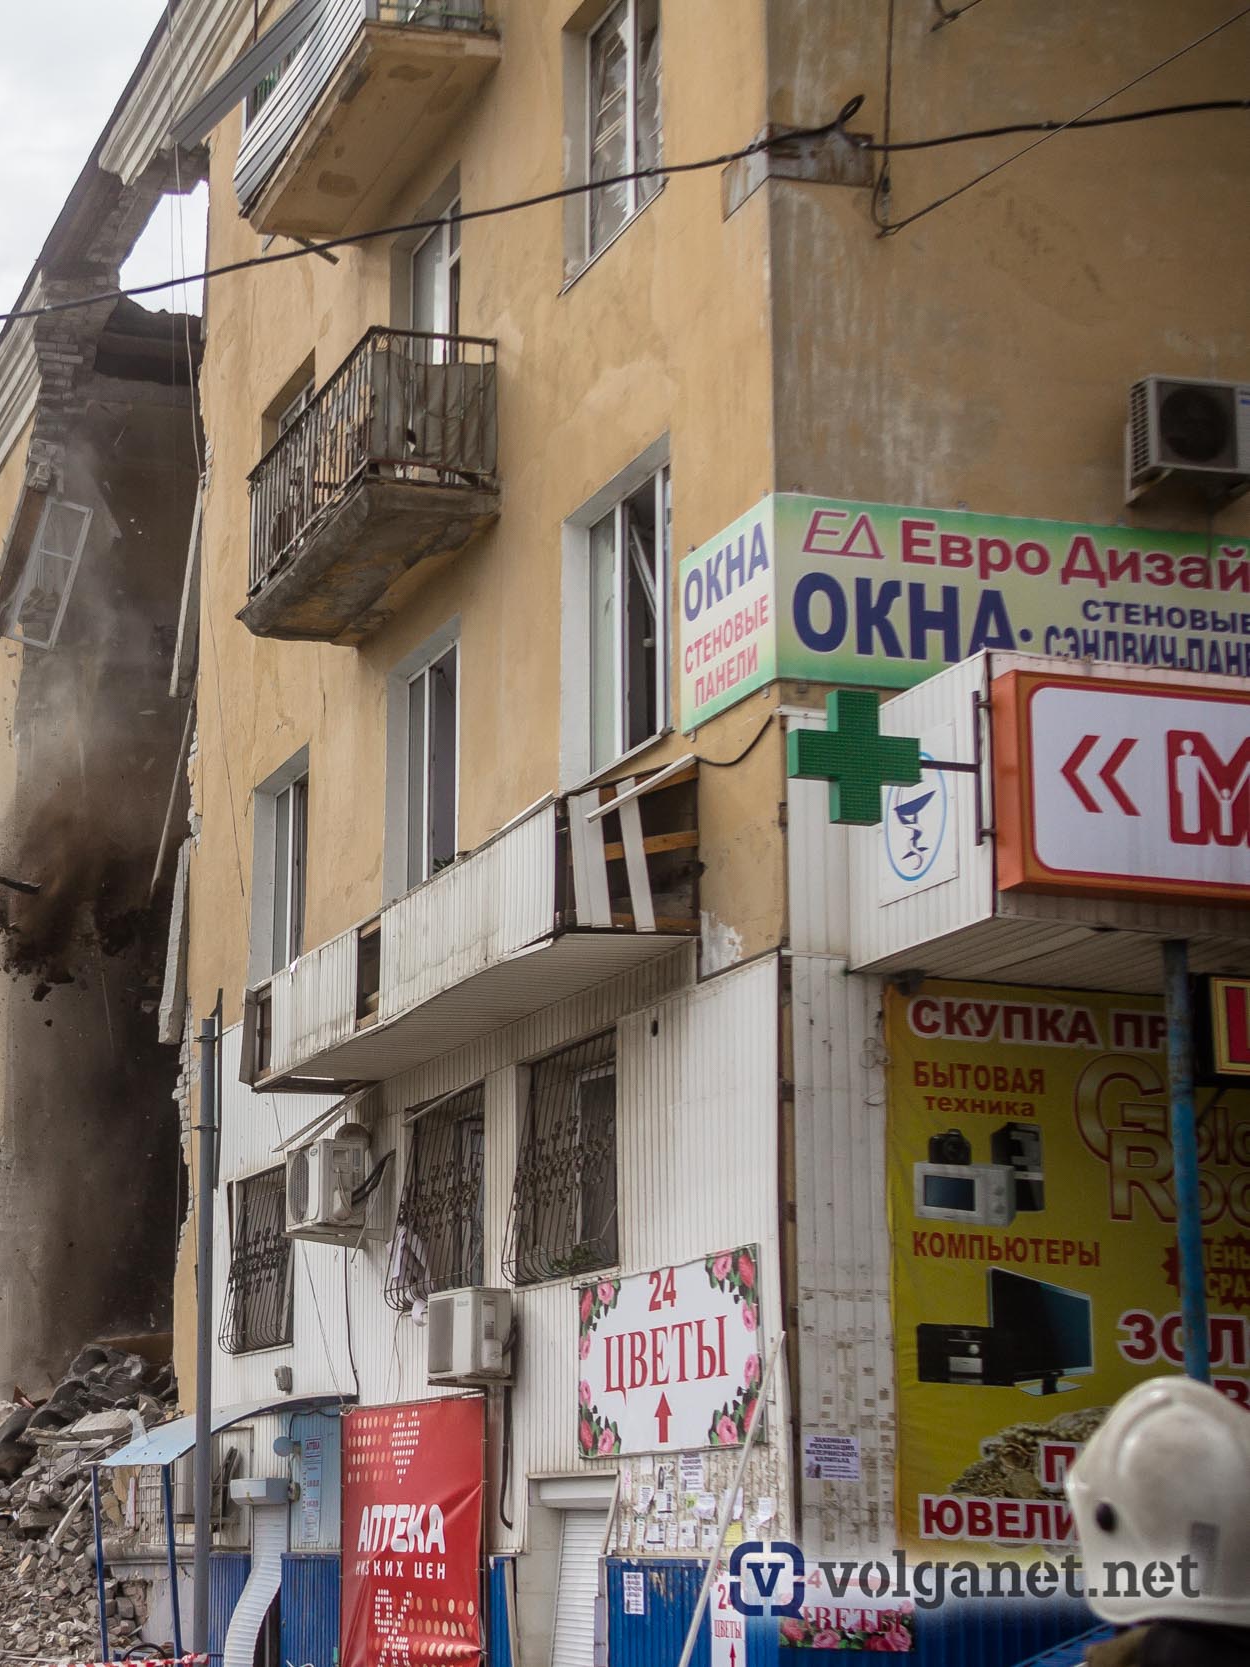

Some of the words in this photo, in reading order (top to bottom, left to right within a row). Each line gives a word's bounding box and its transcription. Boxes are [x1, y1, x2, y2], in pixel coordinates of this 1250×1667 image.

[684, 521, 770, 622] ОКНА
[901, 519, 1050, 581] Евро
[684, 594, 769, 675] СТЕНОВЫЕ
[1082, 599, 1250, 635] СТЕНОВЫЕ
[694, 645, 758, 708] ПАНЕЛИ
[911, 999, 1098, 1045] СКУПКА
[913, 1060, 1046, 1095] БЫТОВАЯ
[924, 1094, 1037, 1117] техника
[913, 1231, 1101, 1268] КОМПЬЮТЕРЫ
[649, 1265, 676, 1311] 24
[604, 1314, 730, 1406] ЦВЕТЫ
[357, 1503, 446, 1554] АПТЕКА
[355, 1559, 404, 1578] НИЗКИХ
[414, 1561, 446, 1580] ЦЕН
[713, 1619, 742, 1640] ЦВЕТЫ
